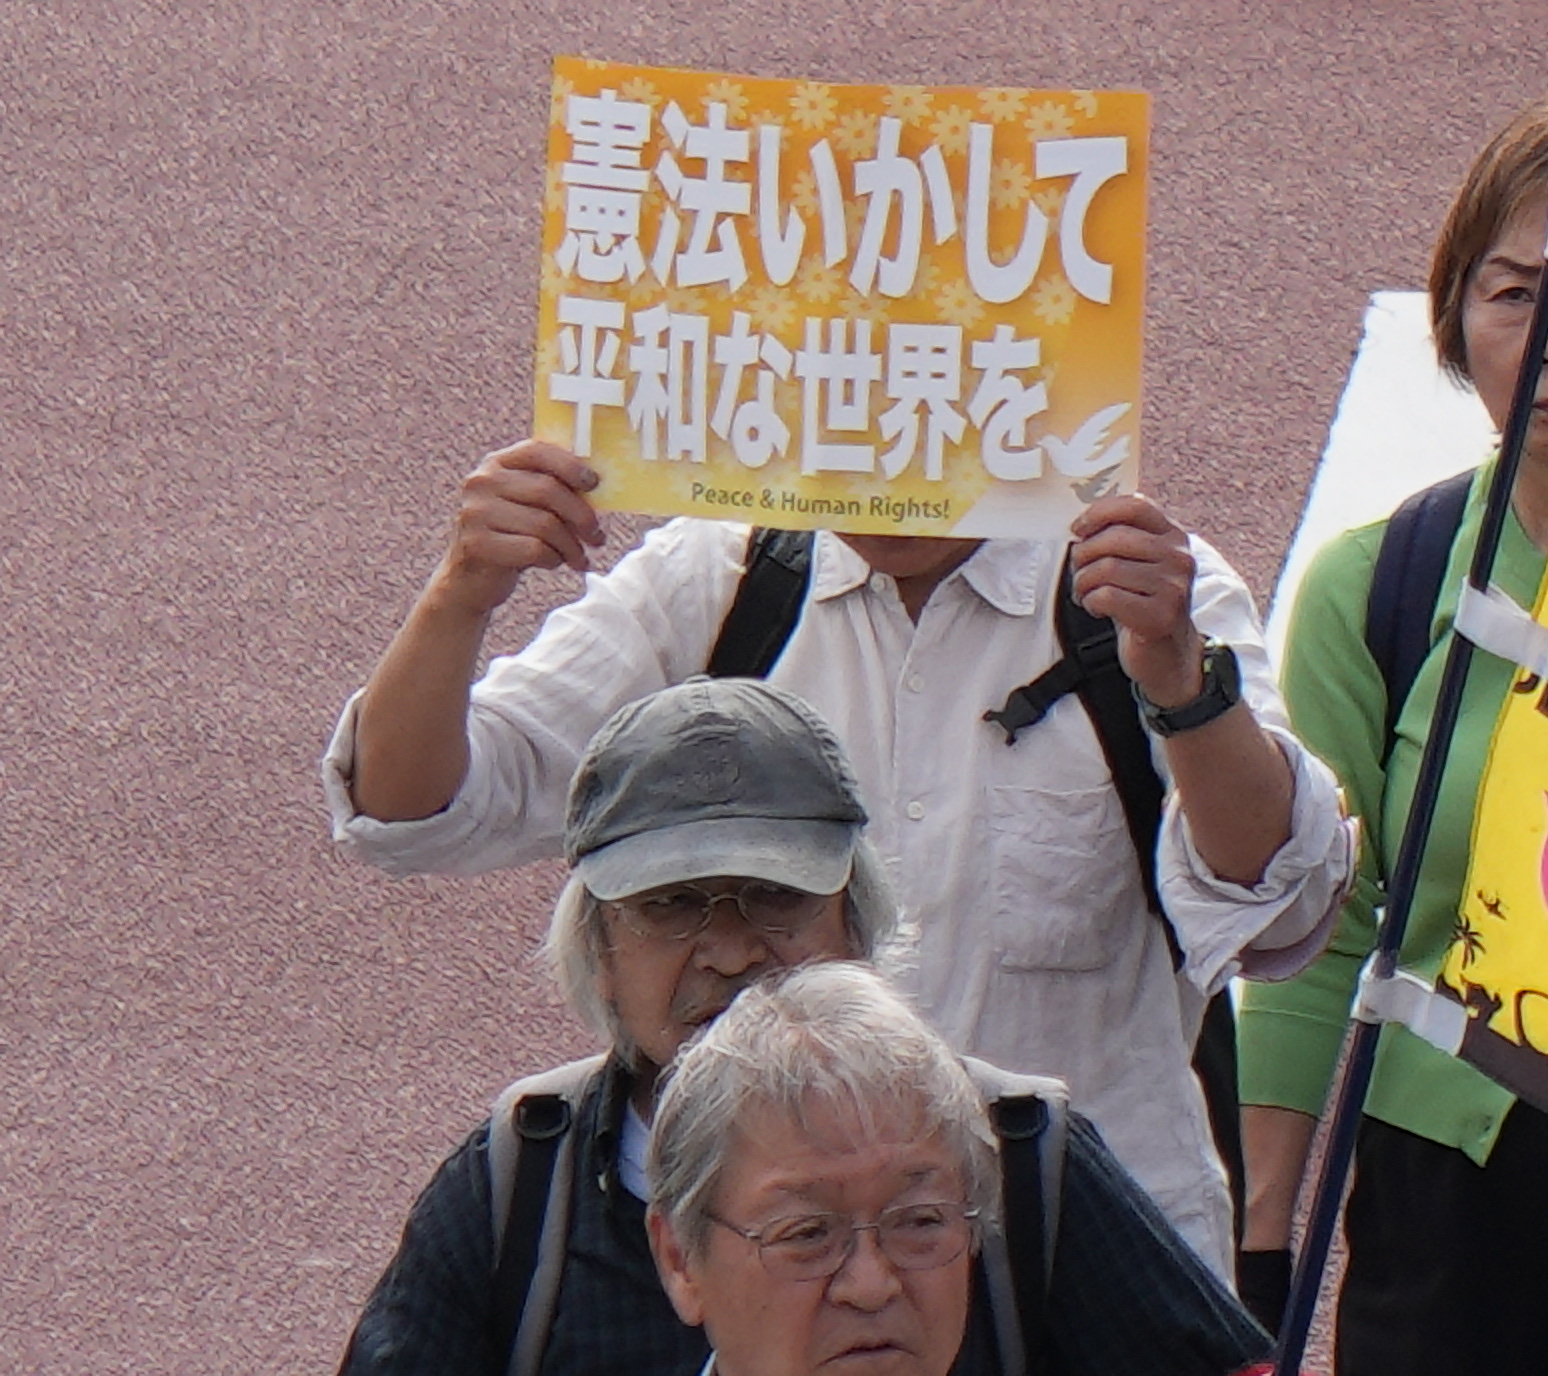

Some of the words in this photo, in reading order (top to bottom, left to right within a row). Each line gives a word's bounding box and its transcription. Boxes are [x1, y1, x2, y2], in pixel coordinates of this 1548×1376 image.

[555, 88, 1129, 306] 憲法いかして
[547, 294, 1052, 483] 平和な世界を
[691, 481, 754, 508] Peace
[759, 488, 776, 510] &
[780, 490, 862, 517] Human
[868, 495, 951, 523] Rights!
